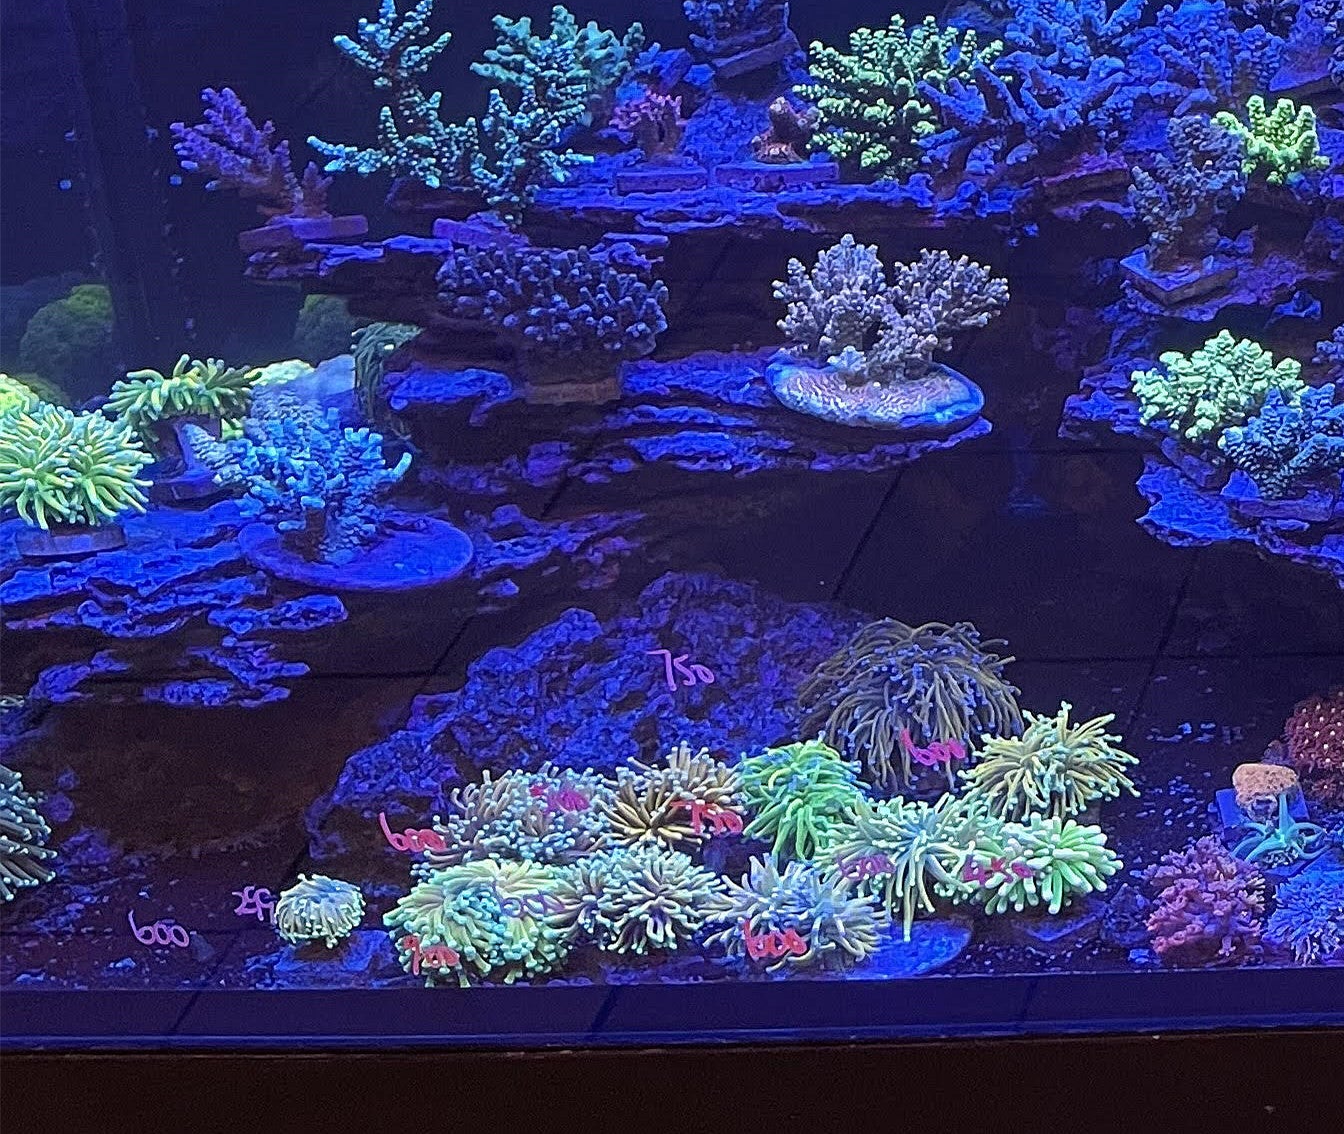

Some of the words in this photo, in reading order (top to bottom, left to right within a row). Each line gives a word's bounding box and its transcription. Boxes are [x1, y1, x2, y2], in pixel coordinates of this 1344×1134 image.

[645, 648, 715, 692] 750
[901, 728, 967, 767] 600
[379, 812, 448, 853] 600
[128, 909, 190, 949] 600
